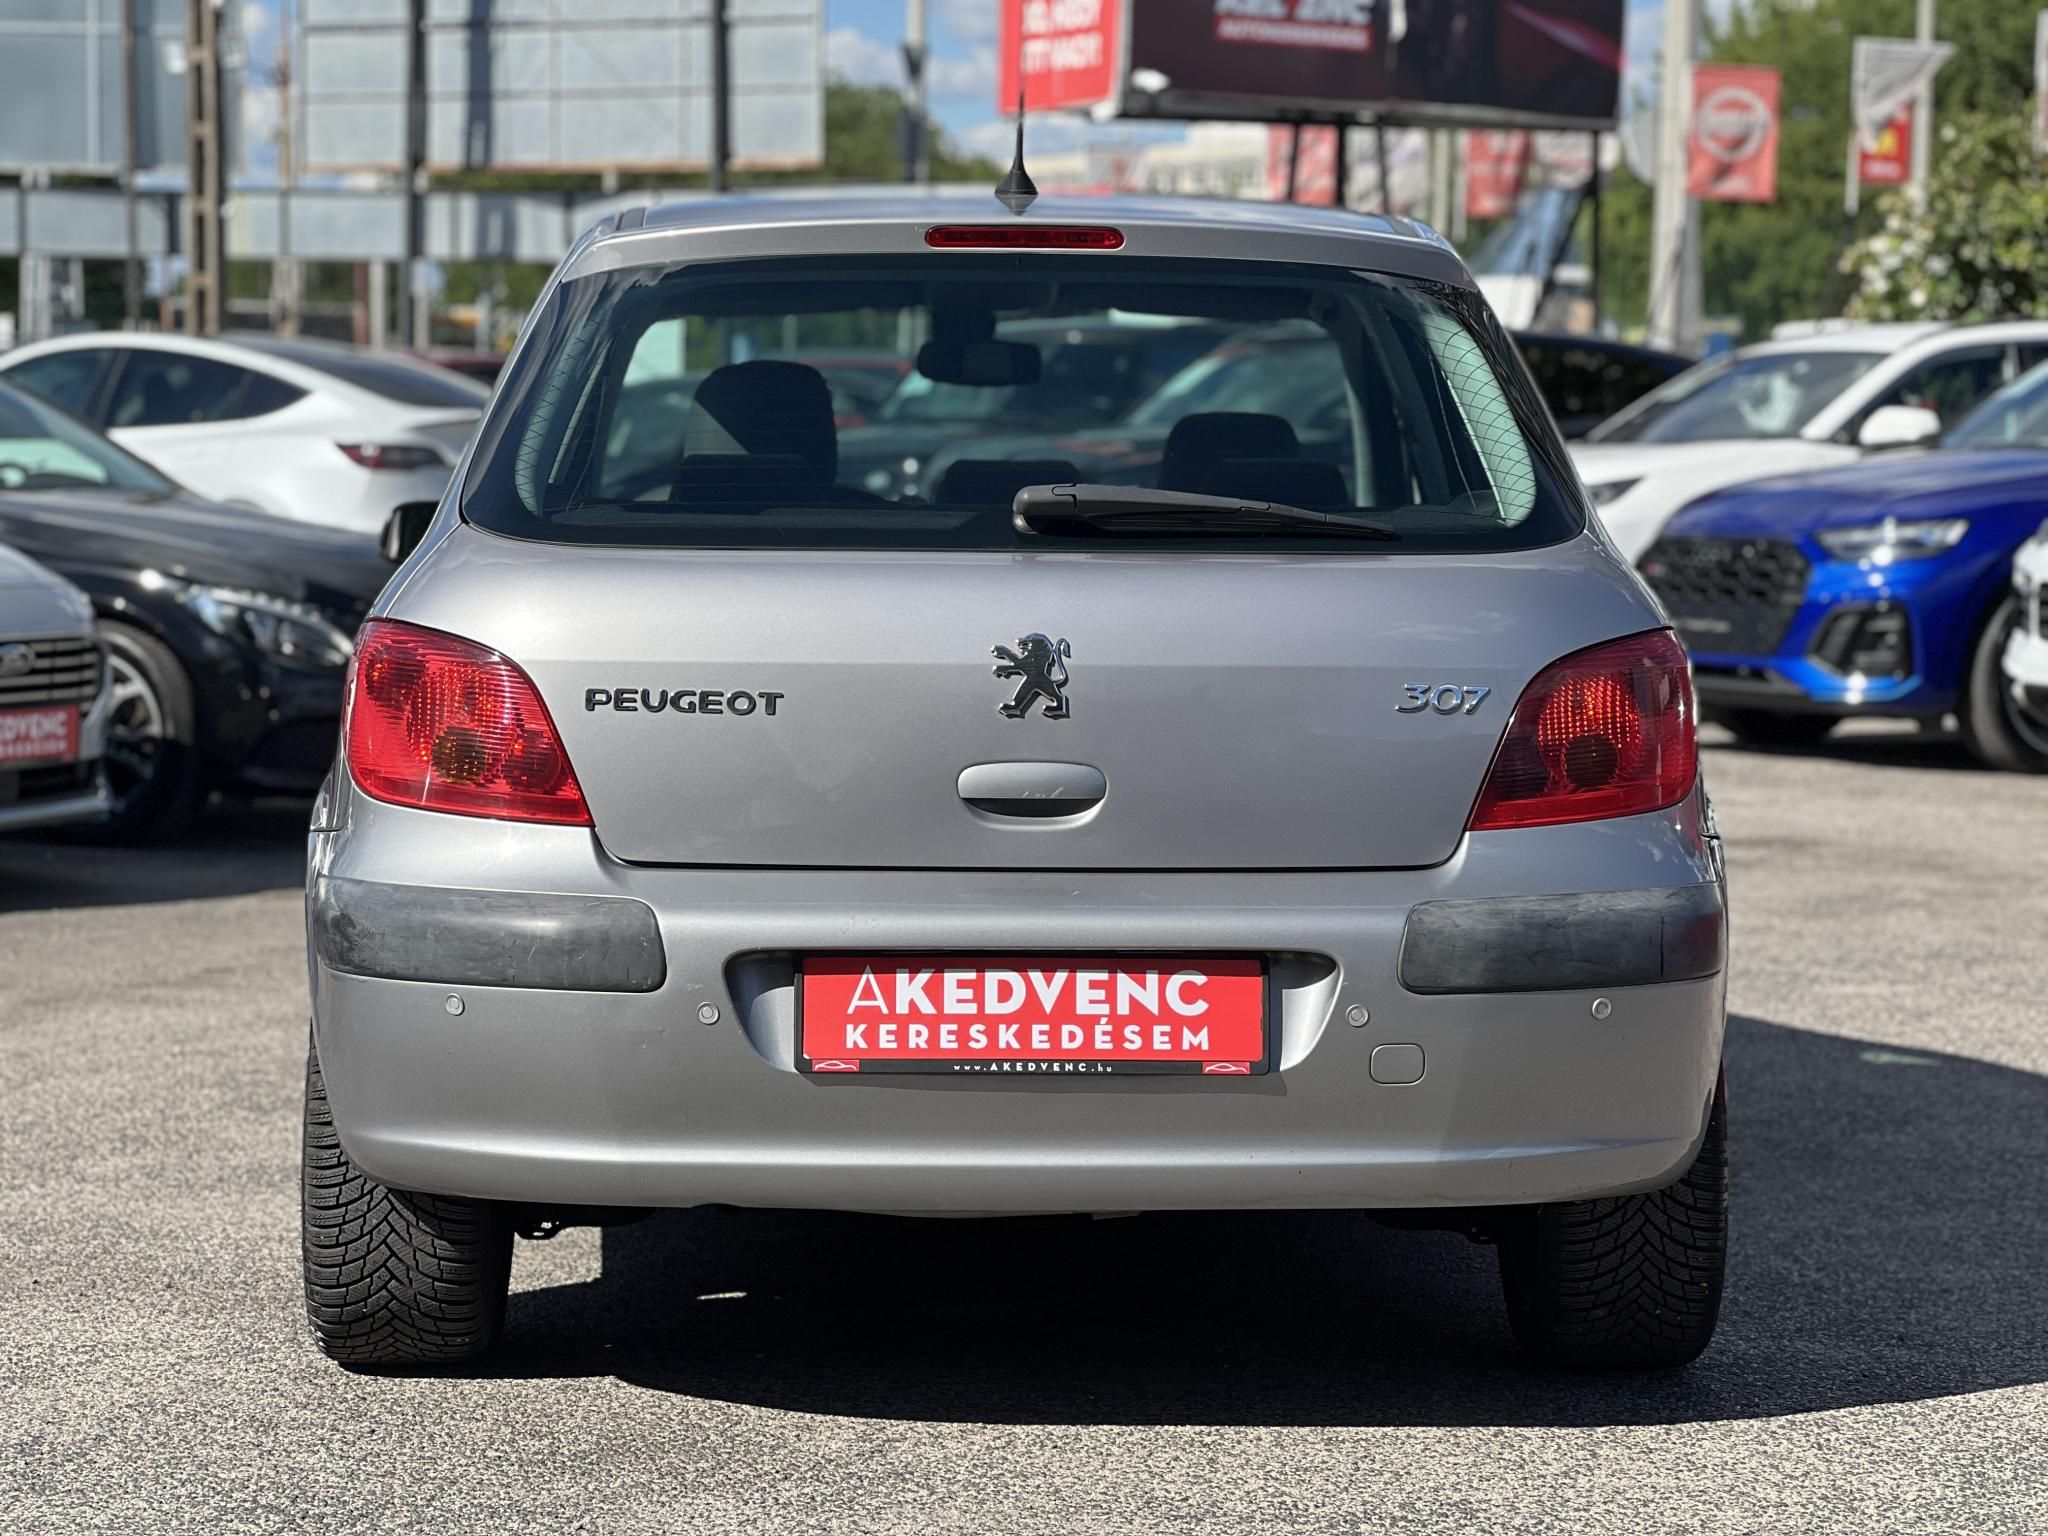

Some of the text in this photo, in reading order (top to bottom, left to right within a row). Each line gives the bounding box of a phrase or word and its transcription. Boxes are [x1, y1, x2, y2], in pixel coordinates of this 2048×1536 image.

[584, 687, 785, 716] PEUGEOT
[1394, 683, 1491, 715] 307
[845, 1017, 1210, 1051] KERESKEDÉSEM
[953, 1062, 1112, 1072] www.AKEDVENC.hu
